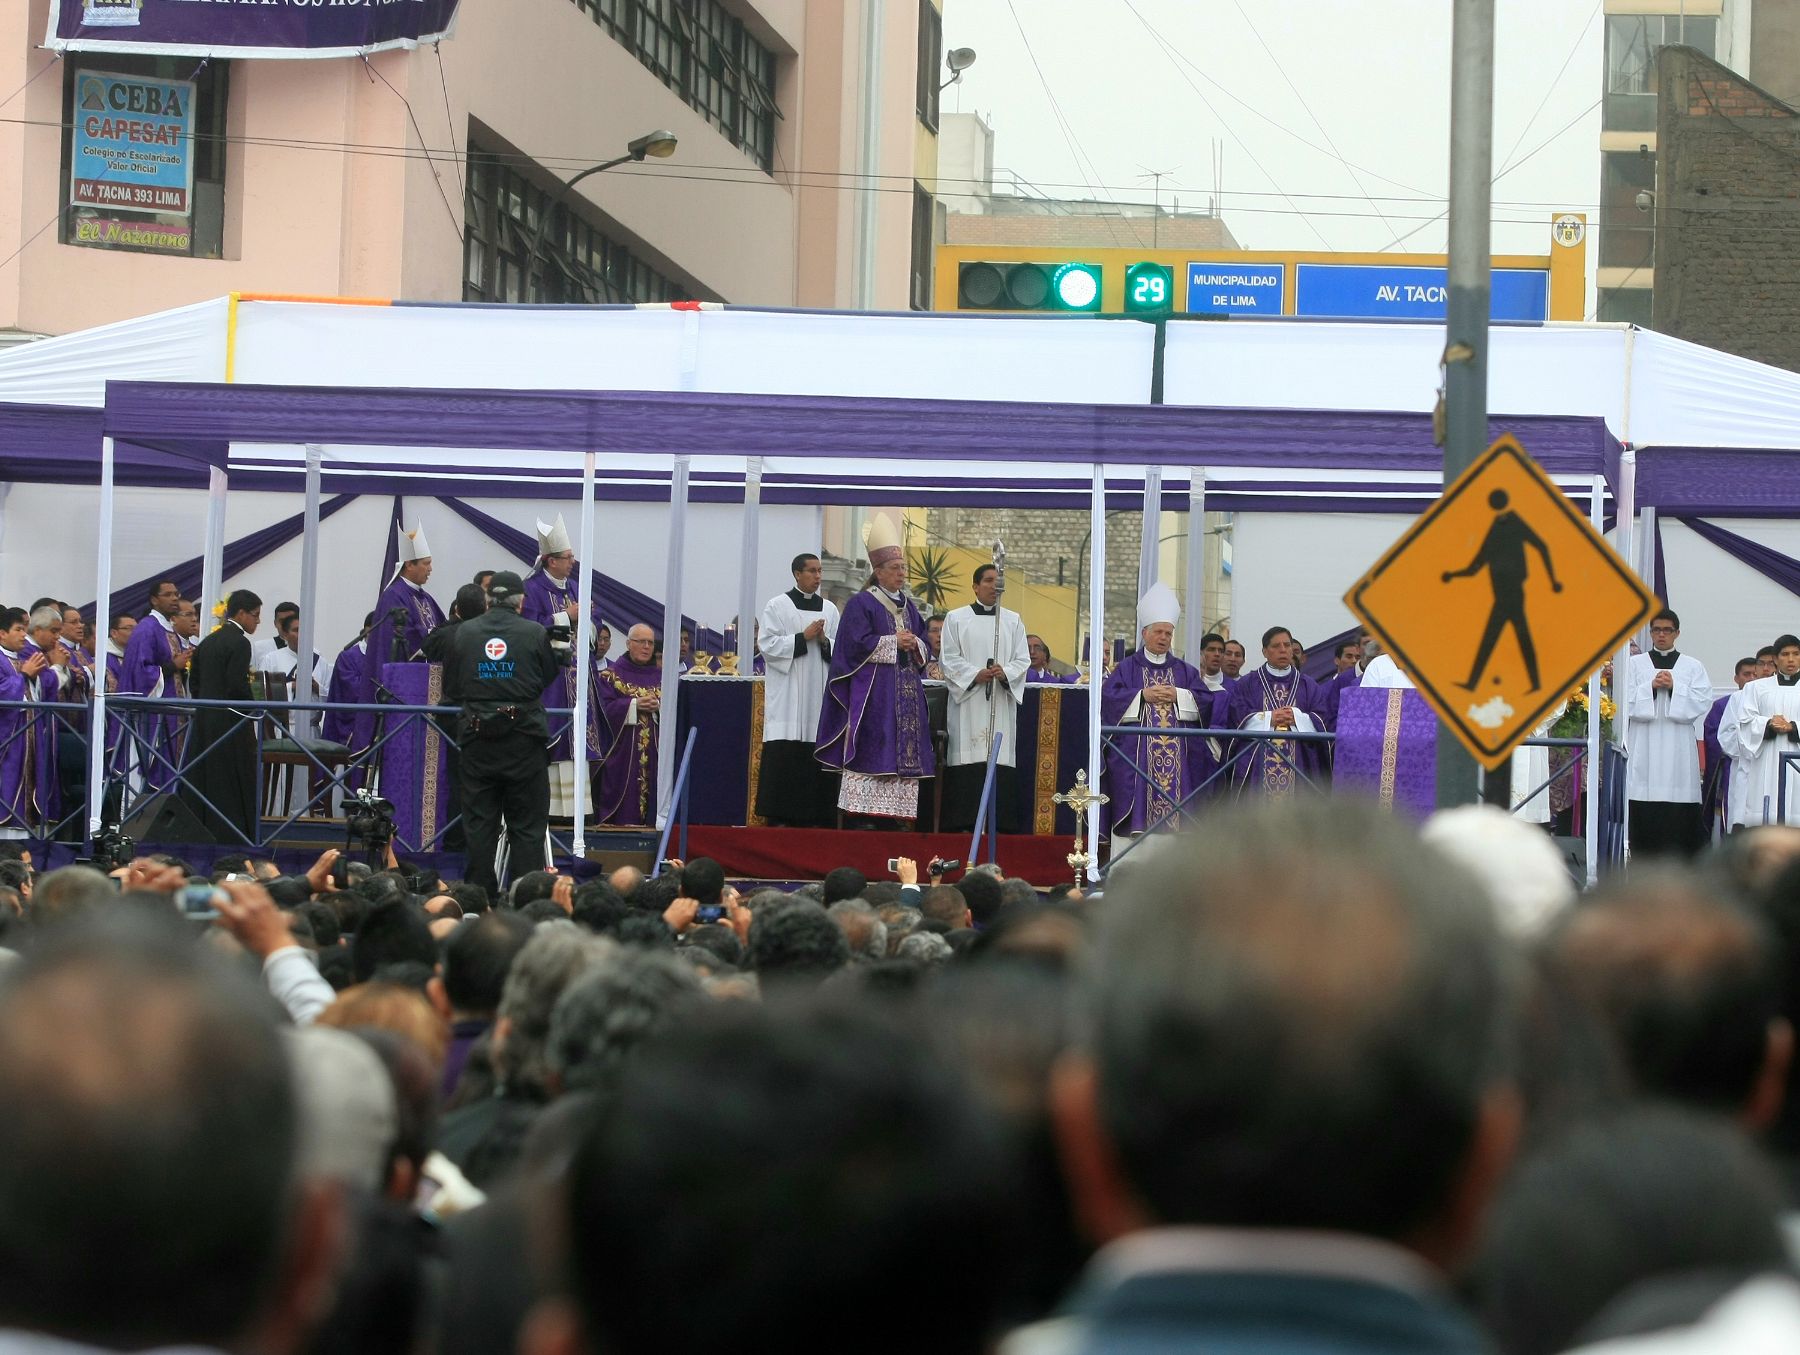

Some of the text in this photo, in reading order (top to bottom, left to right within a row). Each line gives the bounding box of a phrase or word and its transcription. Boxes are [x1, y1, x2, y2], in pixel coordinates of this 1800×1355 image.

[108, 83, 183, 117] CEBA
[85, 116, 181, 146] CAPESAT
[83, 146, 115, 159] Colegio
[129, 151, 181, 164] Escolarizado
[107, 161, 157, 174] Valor Oficial
[79, 184, 181, 206] AV. TACNA 393 LIMA
[78, 222, 190, 248] El Nazareno
[1134, 277, 1165, 302] 29
[1193, 274, 1277, 287] MUNICIPALIDAD
[1212, 295, 1257, 306] DE LIMA
[1375, 285, 1448, 303] AV. TACN
[478, 662, 515, 672] PAX TV
